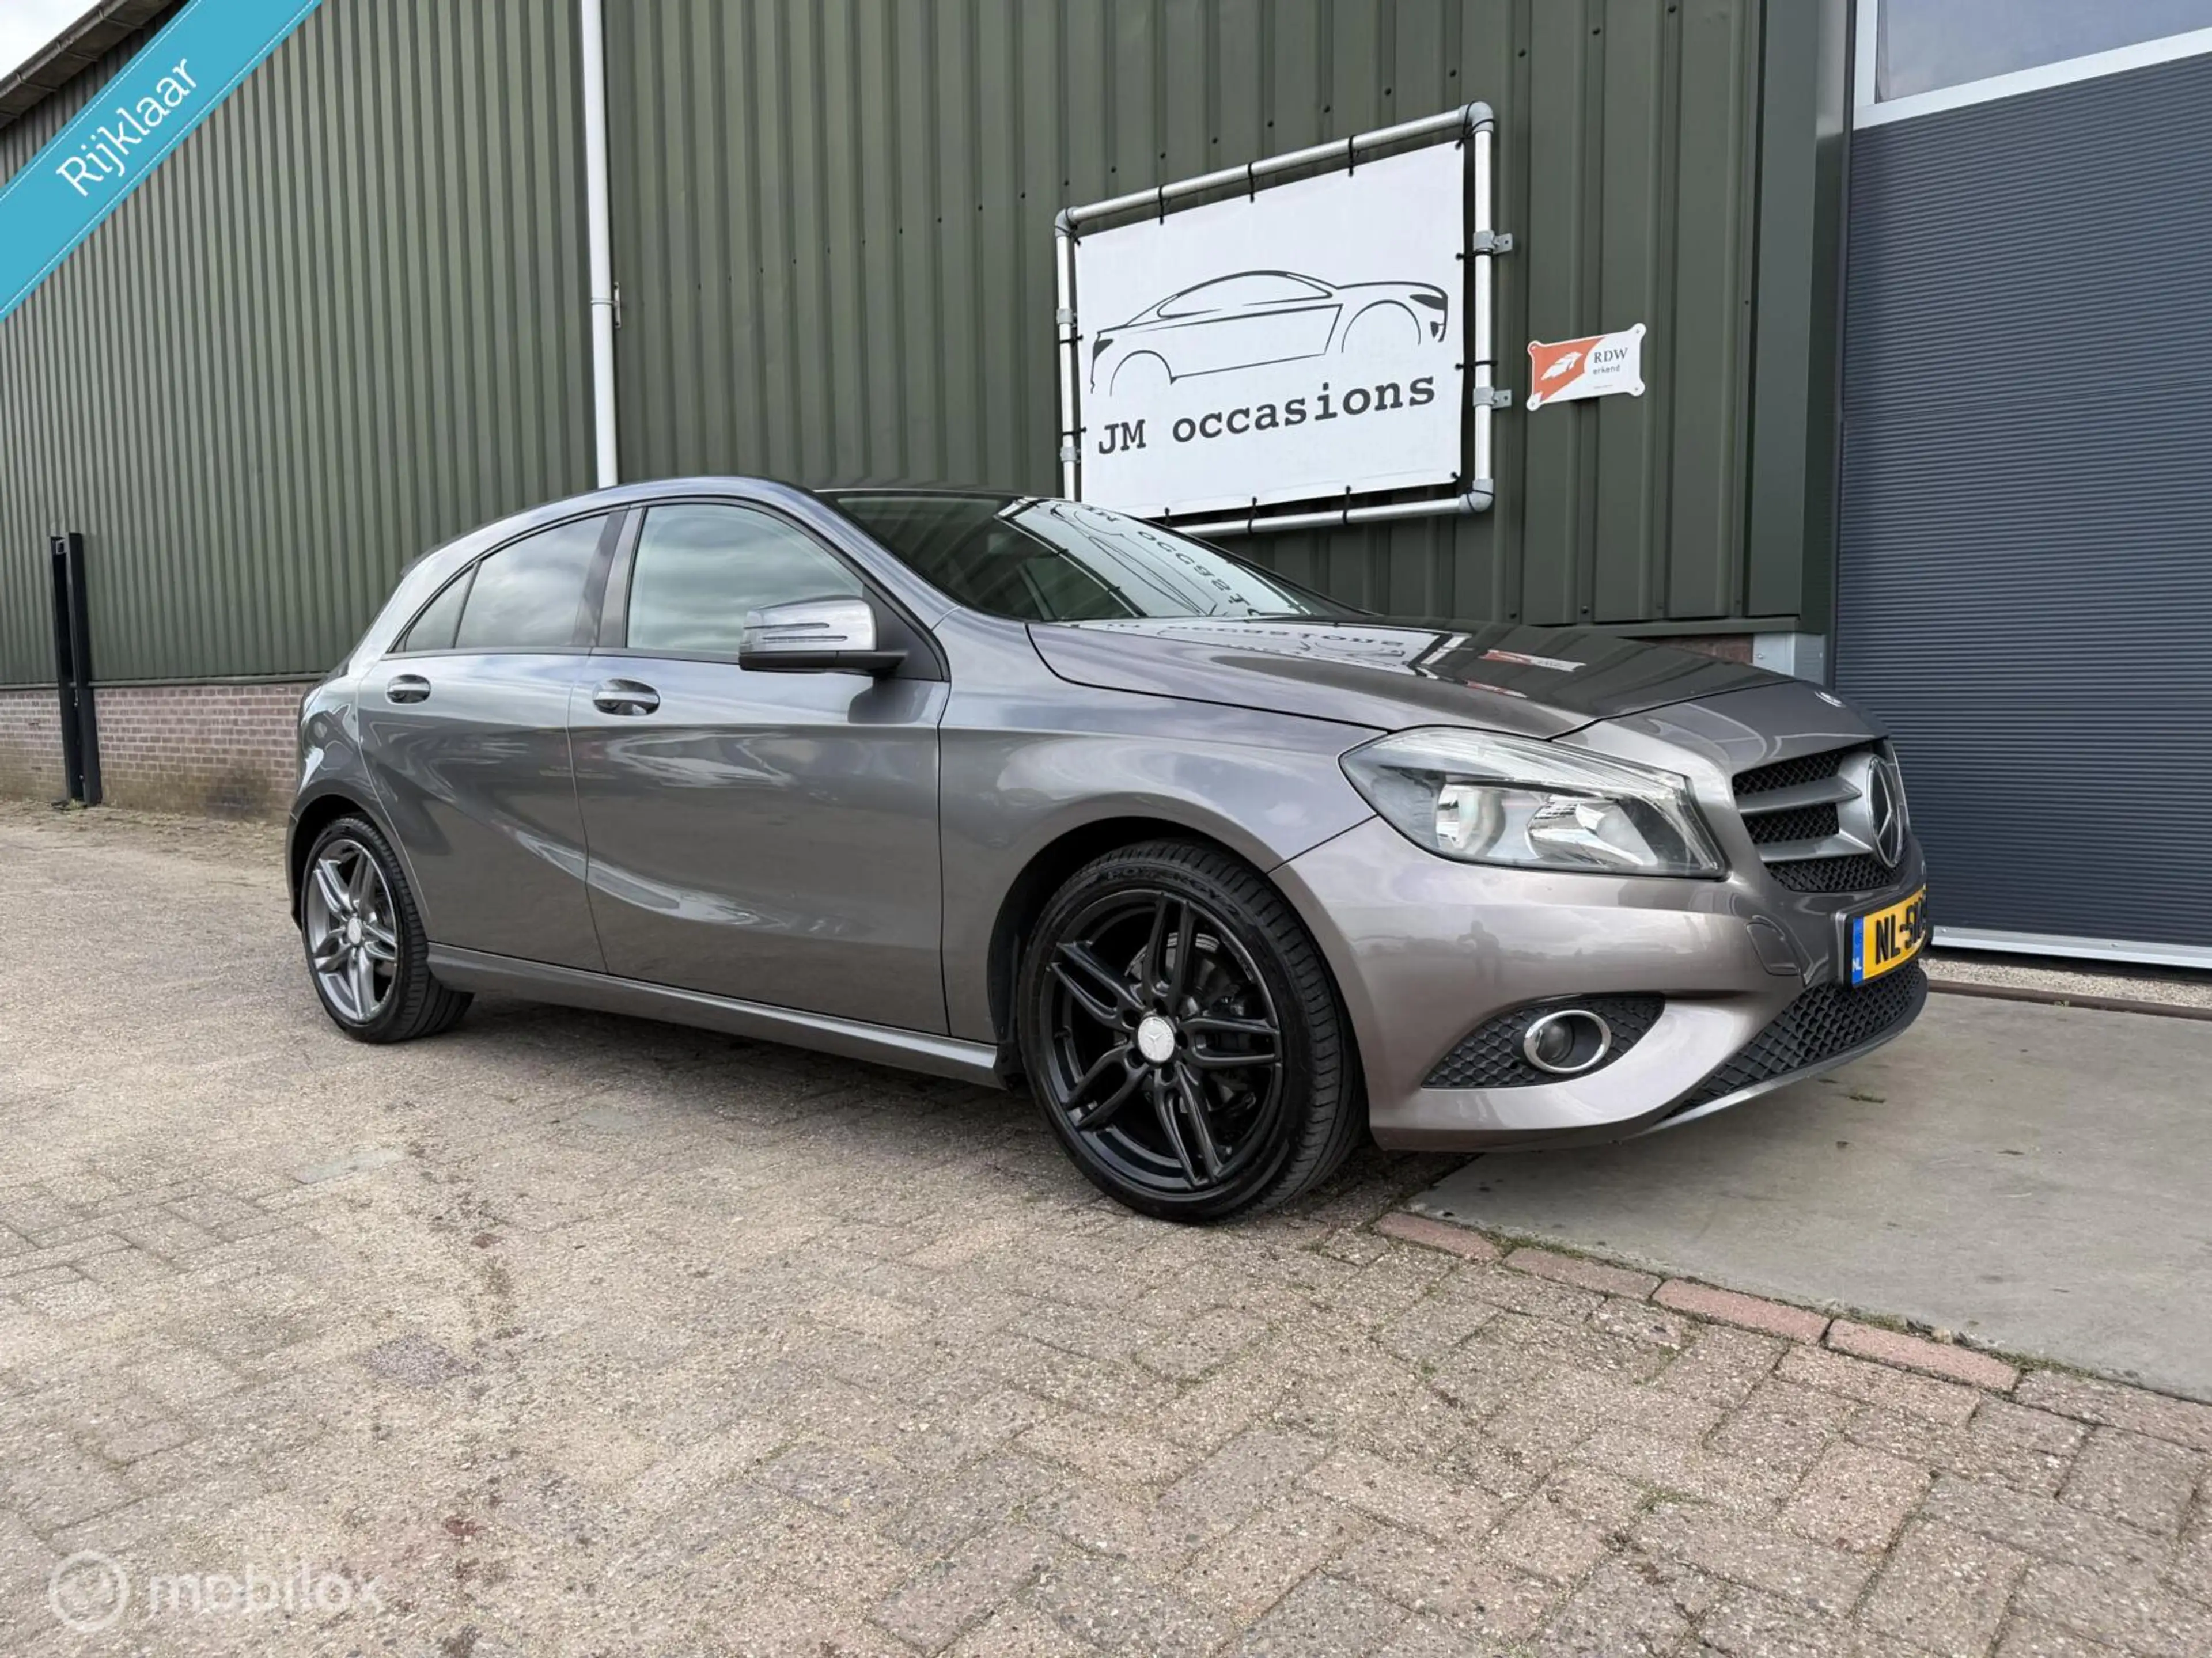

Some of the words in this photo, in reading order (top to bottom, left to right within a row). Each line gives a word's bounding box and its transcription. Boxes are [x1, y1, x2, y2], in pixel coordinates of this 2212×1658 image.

[1593, 347, 1628, 364] RDW
[1592, 363, 1621, 375] erkend
[1098, 419, 1146, 455] JM
[1172, 376, 1435, 443] occasions
